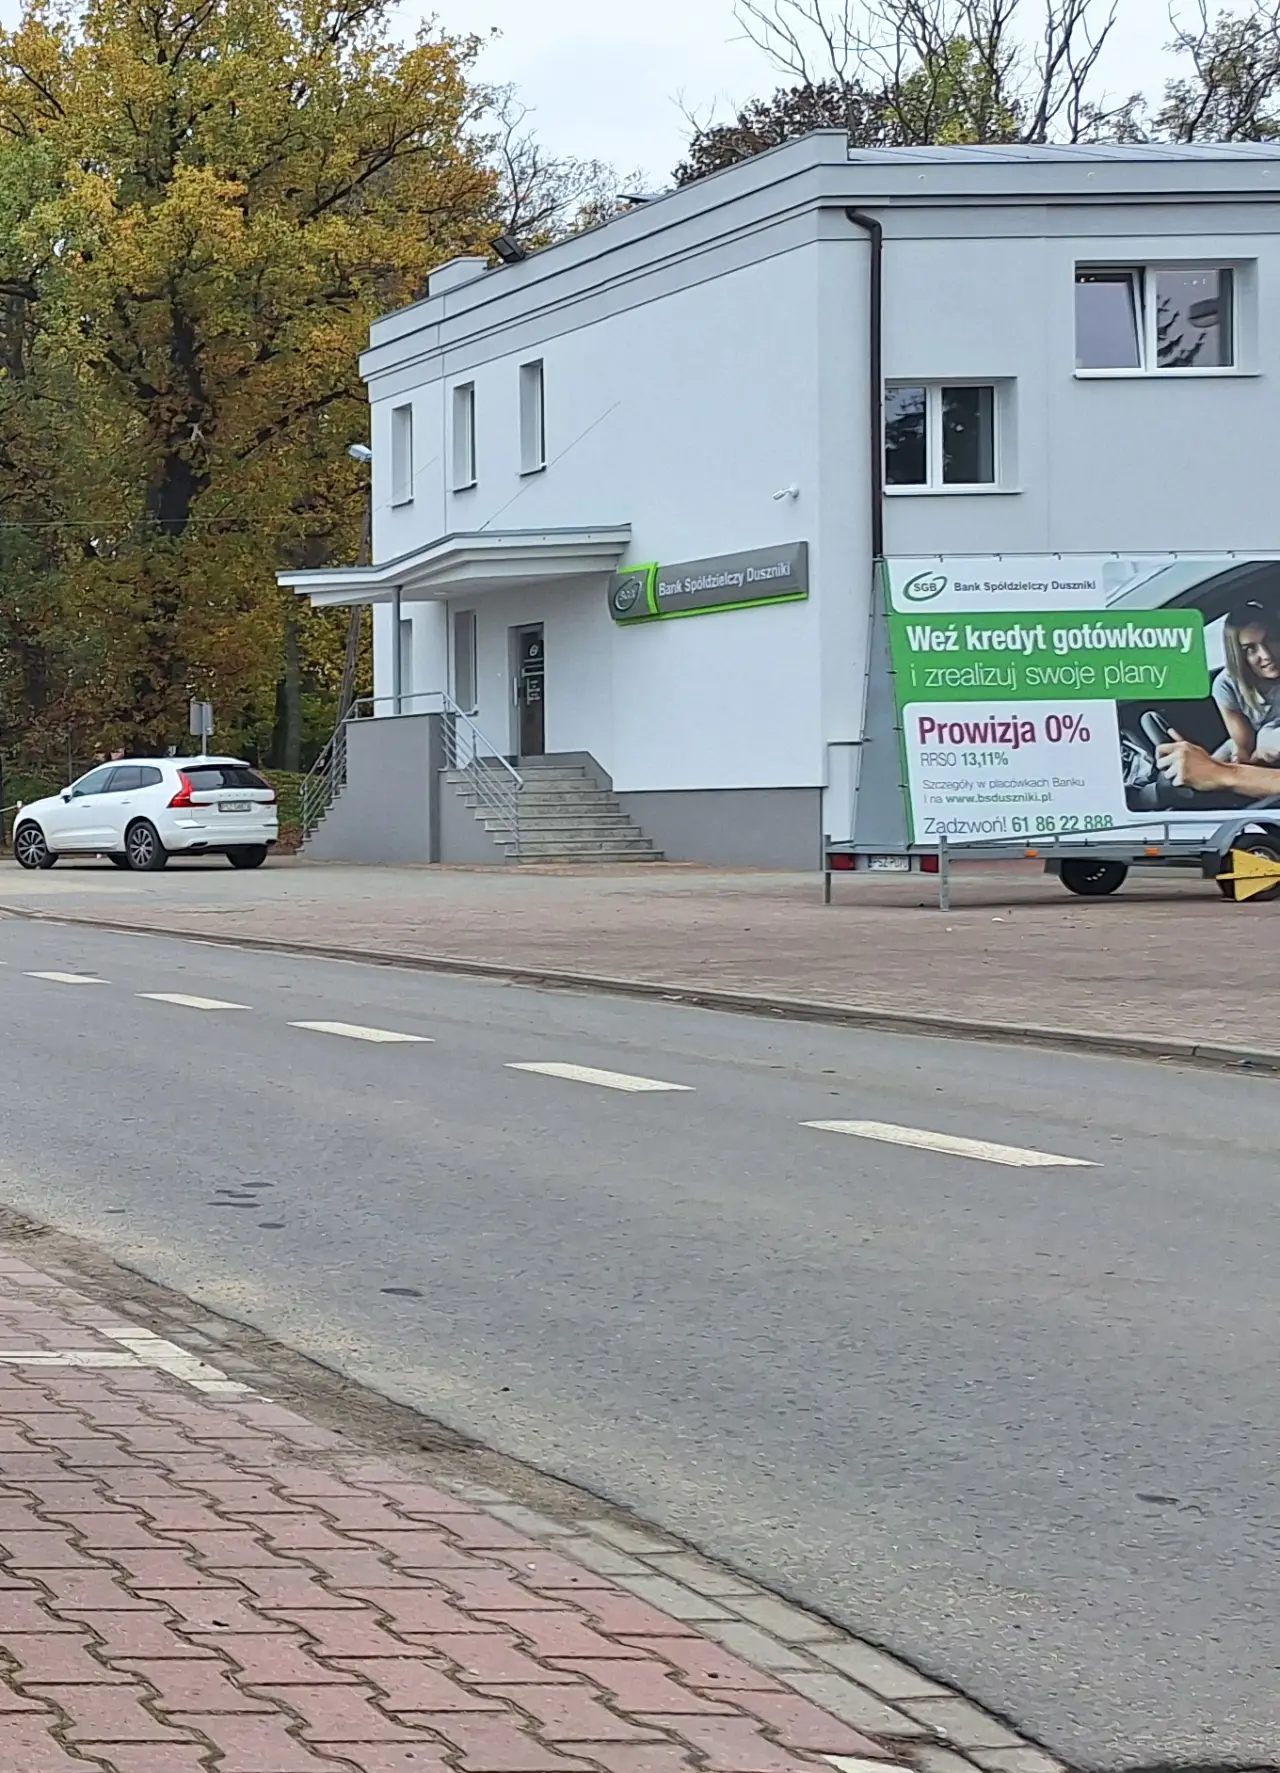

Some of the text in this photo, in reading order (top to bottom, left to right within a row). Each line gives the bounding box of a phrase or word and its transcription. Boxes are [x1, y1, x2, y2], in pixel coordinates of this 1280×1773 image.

[658, 562, 791, 597] Bank Spółdzielczy Duszniki
[913, 582, 937, 592] SGB
[954, 580, 1096, 593] Bank Spółdzielczy Duszniki
[906, 622, 1193, 655] Weź kredyt gotówkowy
[910, 660, 1168, 690] i zrealizuj swoje plany
[918, 714, 1091, 749] Prowizja 0%
[920, 752, 1009, 768] RRSO 13,11%
[922, 776, 1085, 792] Szczegóły w placówkach Banku
[929, 795, 943, 804] na
[924, 814, 1113, 835] Zadzwoń! 61 86 22 888
